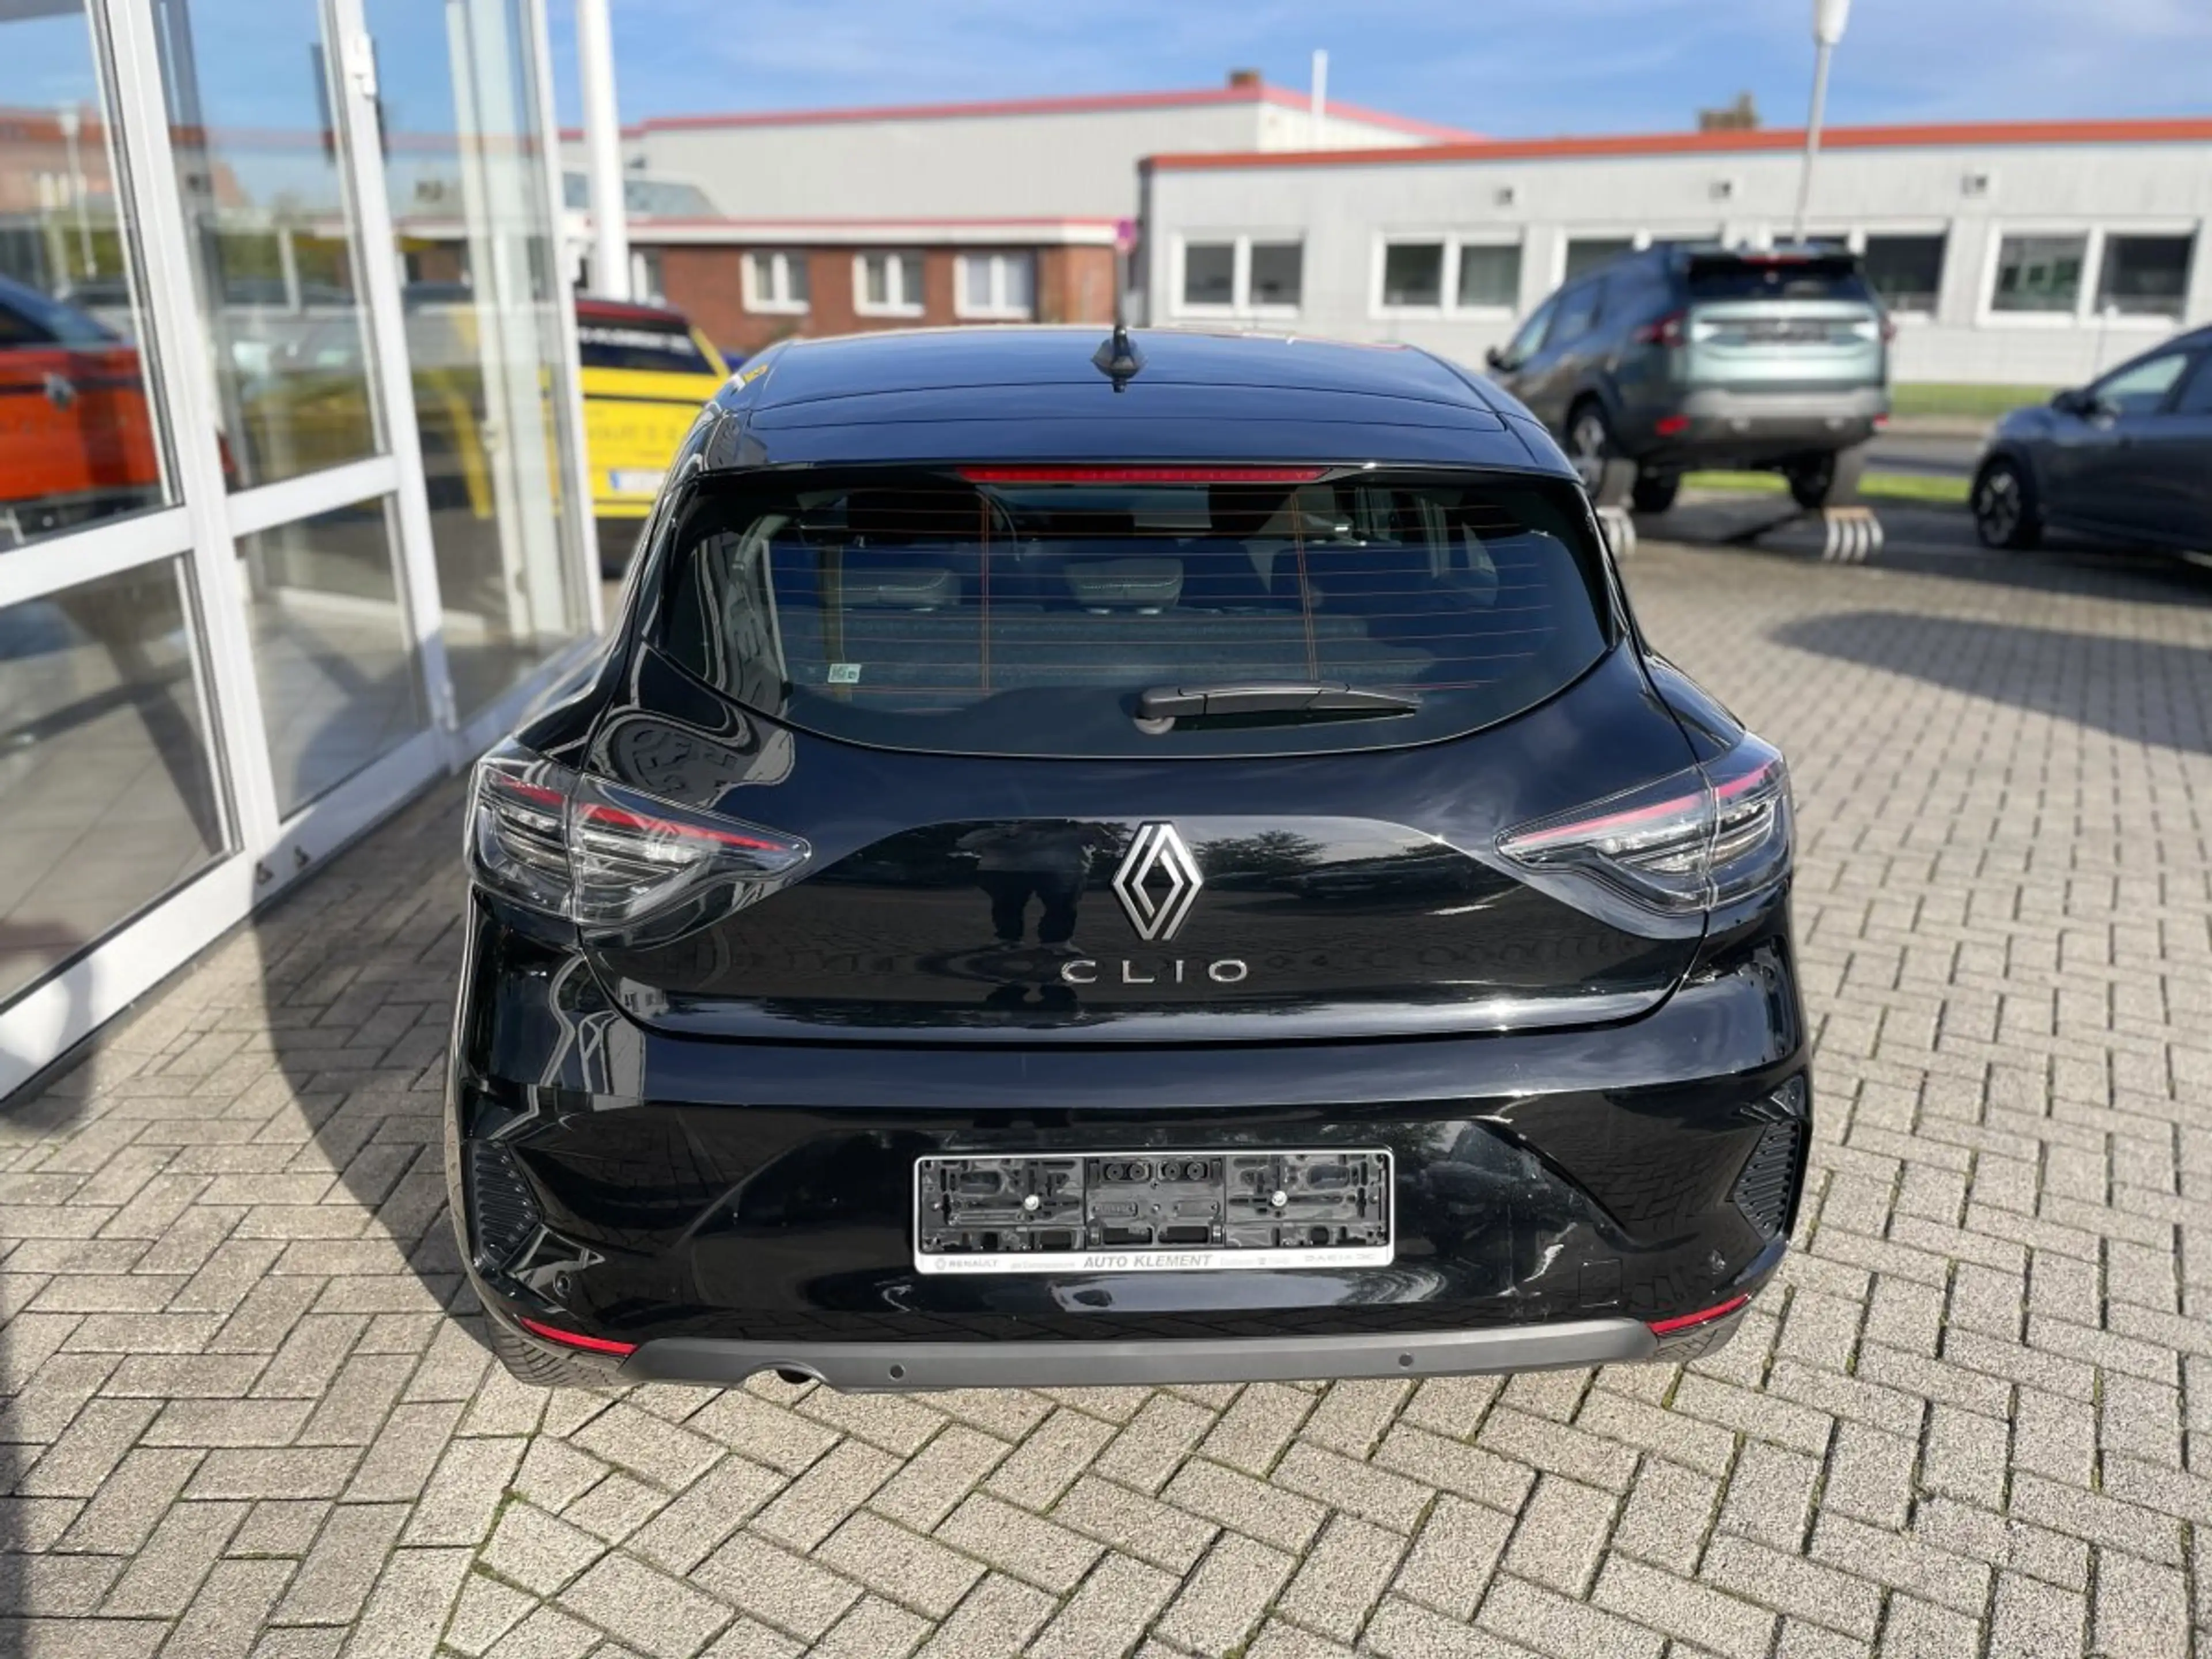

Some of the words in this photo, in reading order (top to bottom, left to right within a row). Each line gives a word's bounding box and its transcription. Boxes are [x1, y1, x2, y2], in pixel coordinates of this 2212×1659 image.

[1061, 960, 1247, 983] CLIO
[1083, 1255, 1128, 1268] AUTO
[1132, 1253, 1214, 1267] KLEMENT
